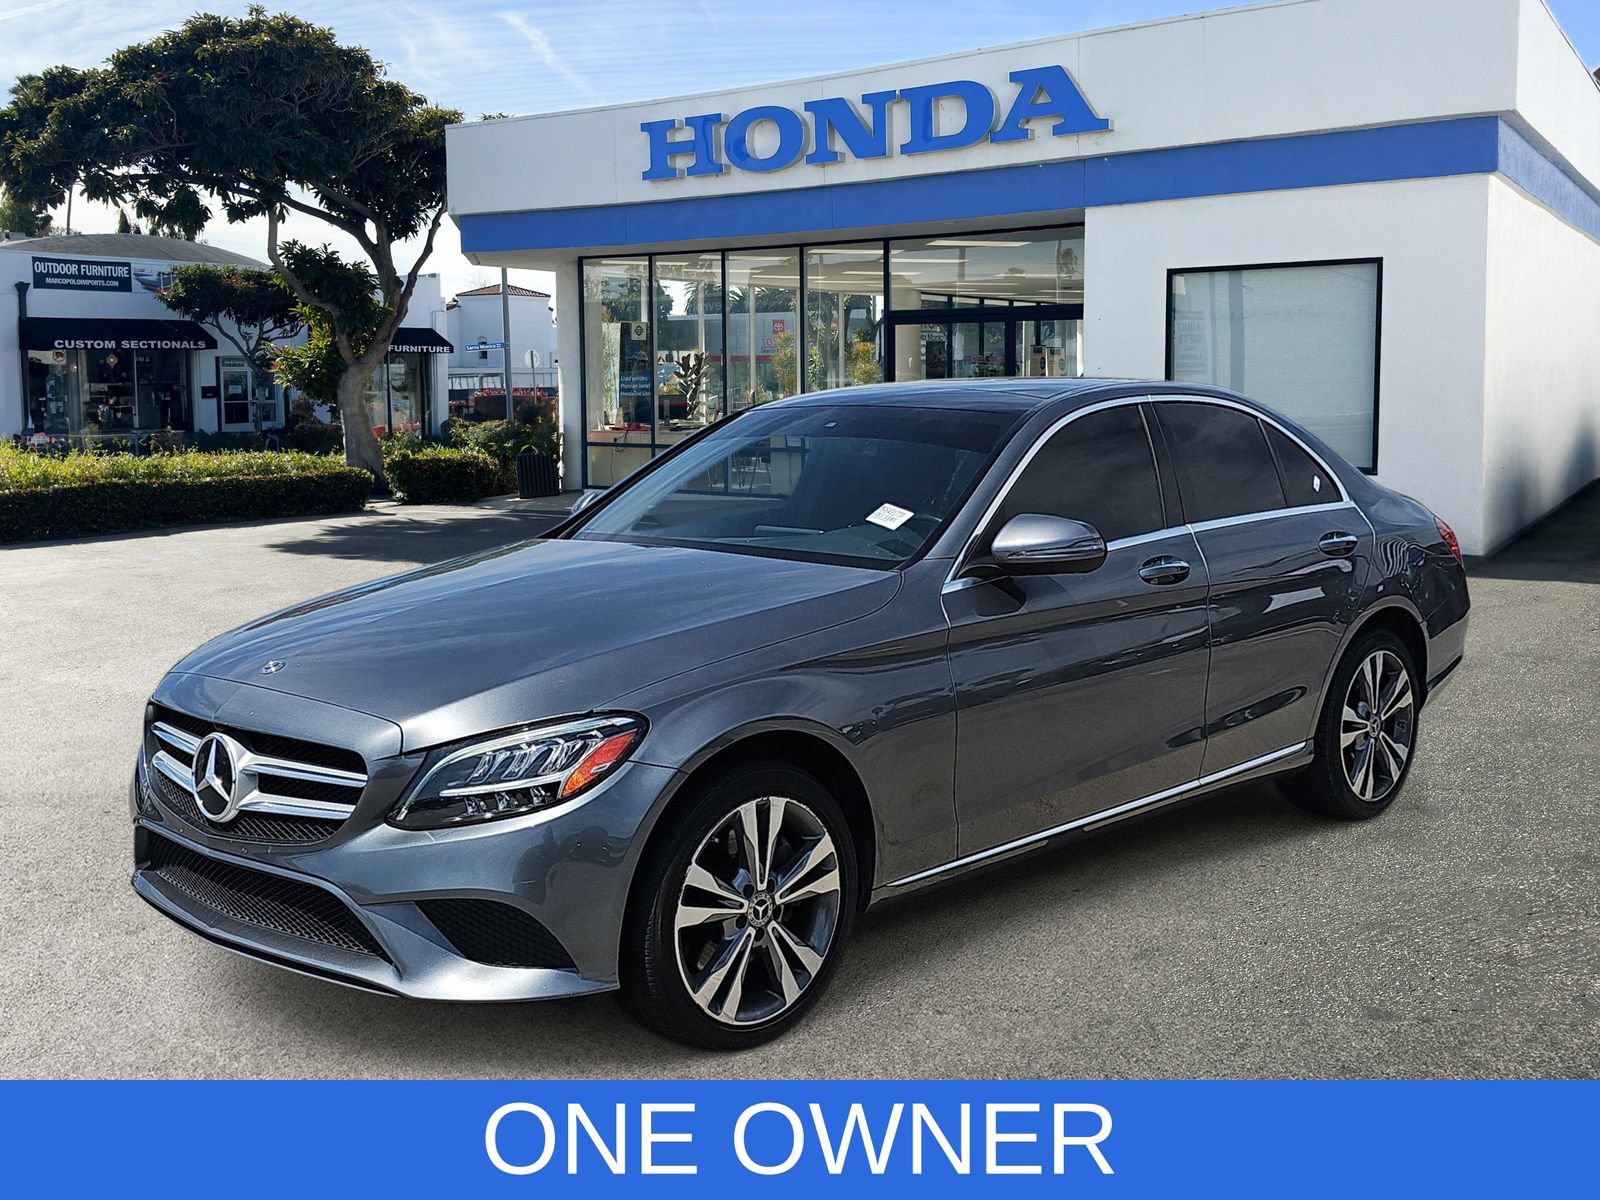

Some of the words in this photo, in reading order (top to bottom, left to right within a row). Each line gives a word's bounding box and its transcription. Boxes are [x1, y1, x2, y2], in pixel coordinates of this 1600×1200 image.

[640, 64, 1112, 181] HONDA
[34, 261, 79, 275] OUTDOOR
[80, 264, 130, 278] FURNITURE
[45, 277, 119, 287] MARCOPOLOIMPORTS.COM
[54, 339, 116, 349] CUSTOM
[121, 340, 206, 349] SECTIONALS
[388, 344, 450, 353] FURNITURE
